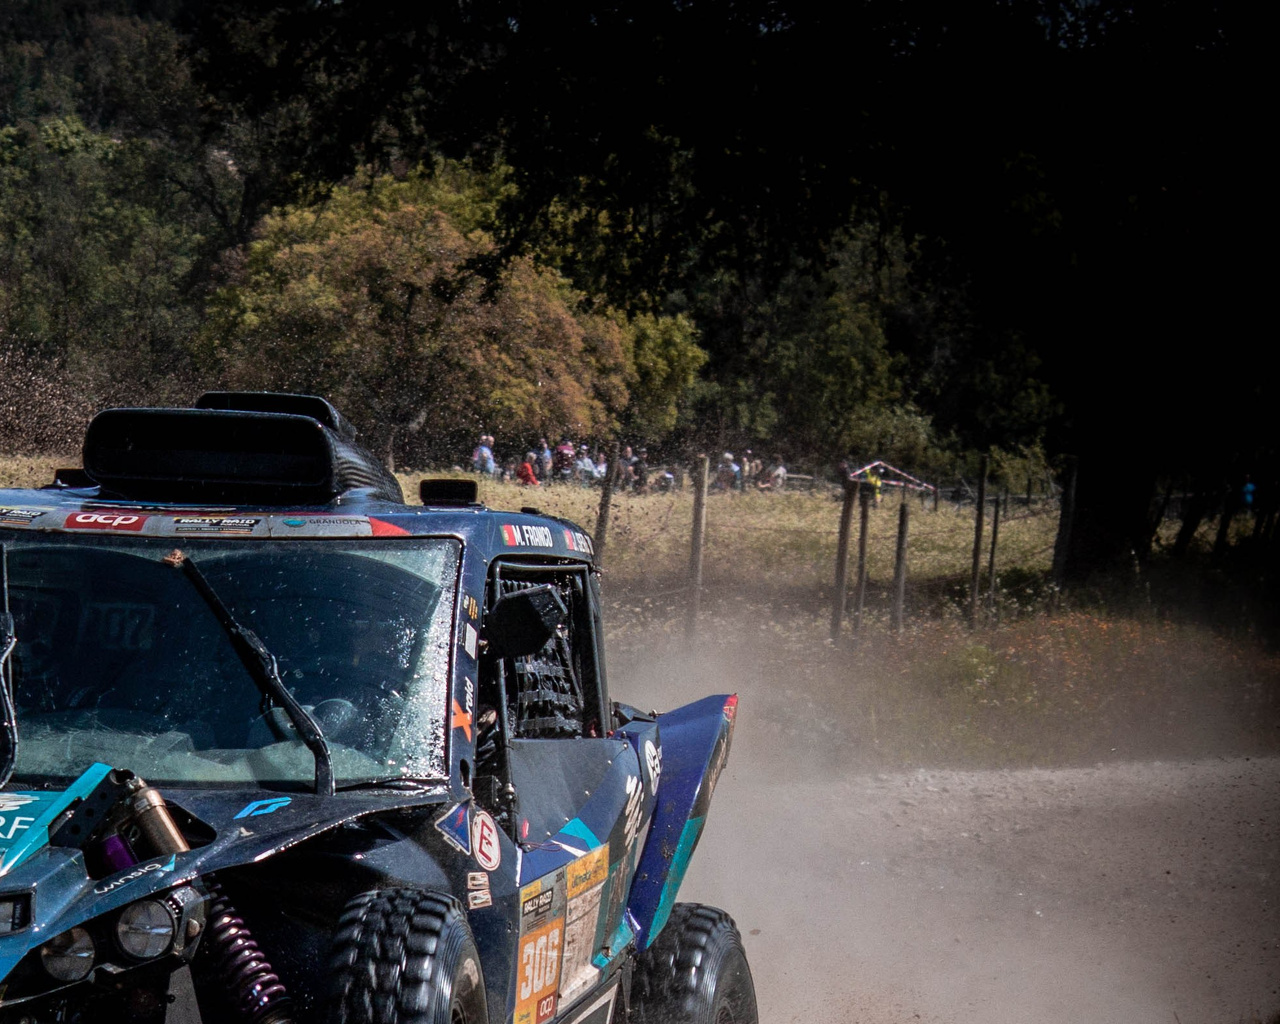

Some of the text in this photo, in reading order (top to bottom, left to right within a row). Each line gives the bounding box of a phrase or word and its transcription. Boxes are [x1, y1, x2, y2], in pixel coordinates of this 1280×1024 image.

[75, 514, 139, 526] acp
[522, 525, 554, 548] FRANCO
[479, 819, 493, 863] E
[93, 863, 162, 895] winsig
[520, 928, 560, 1002] 306
[539, 995, 554, 1018] acp
